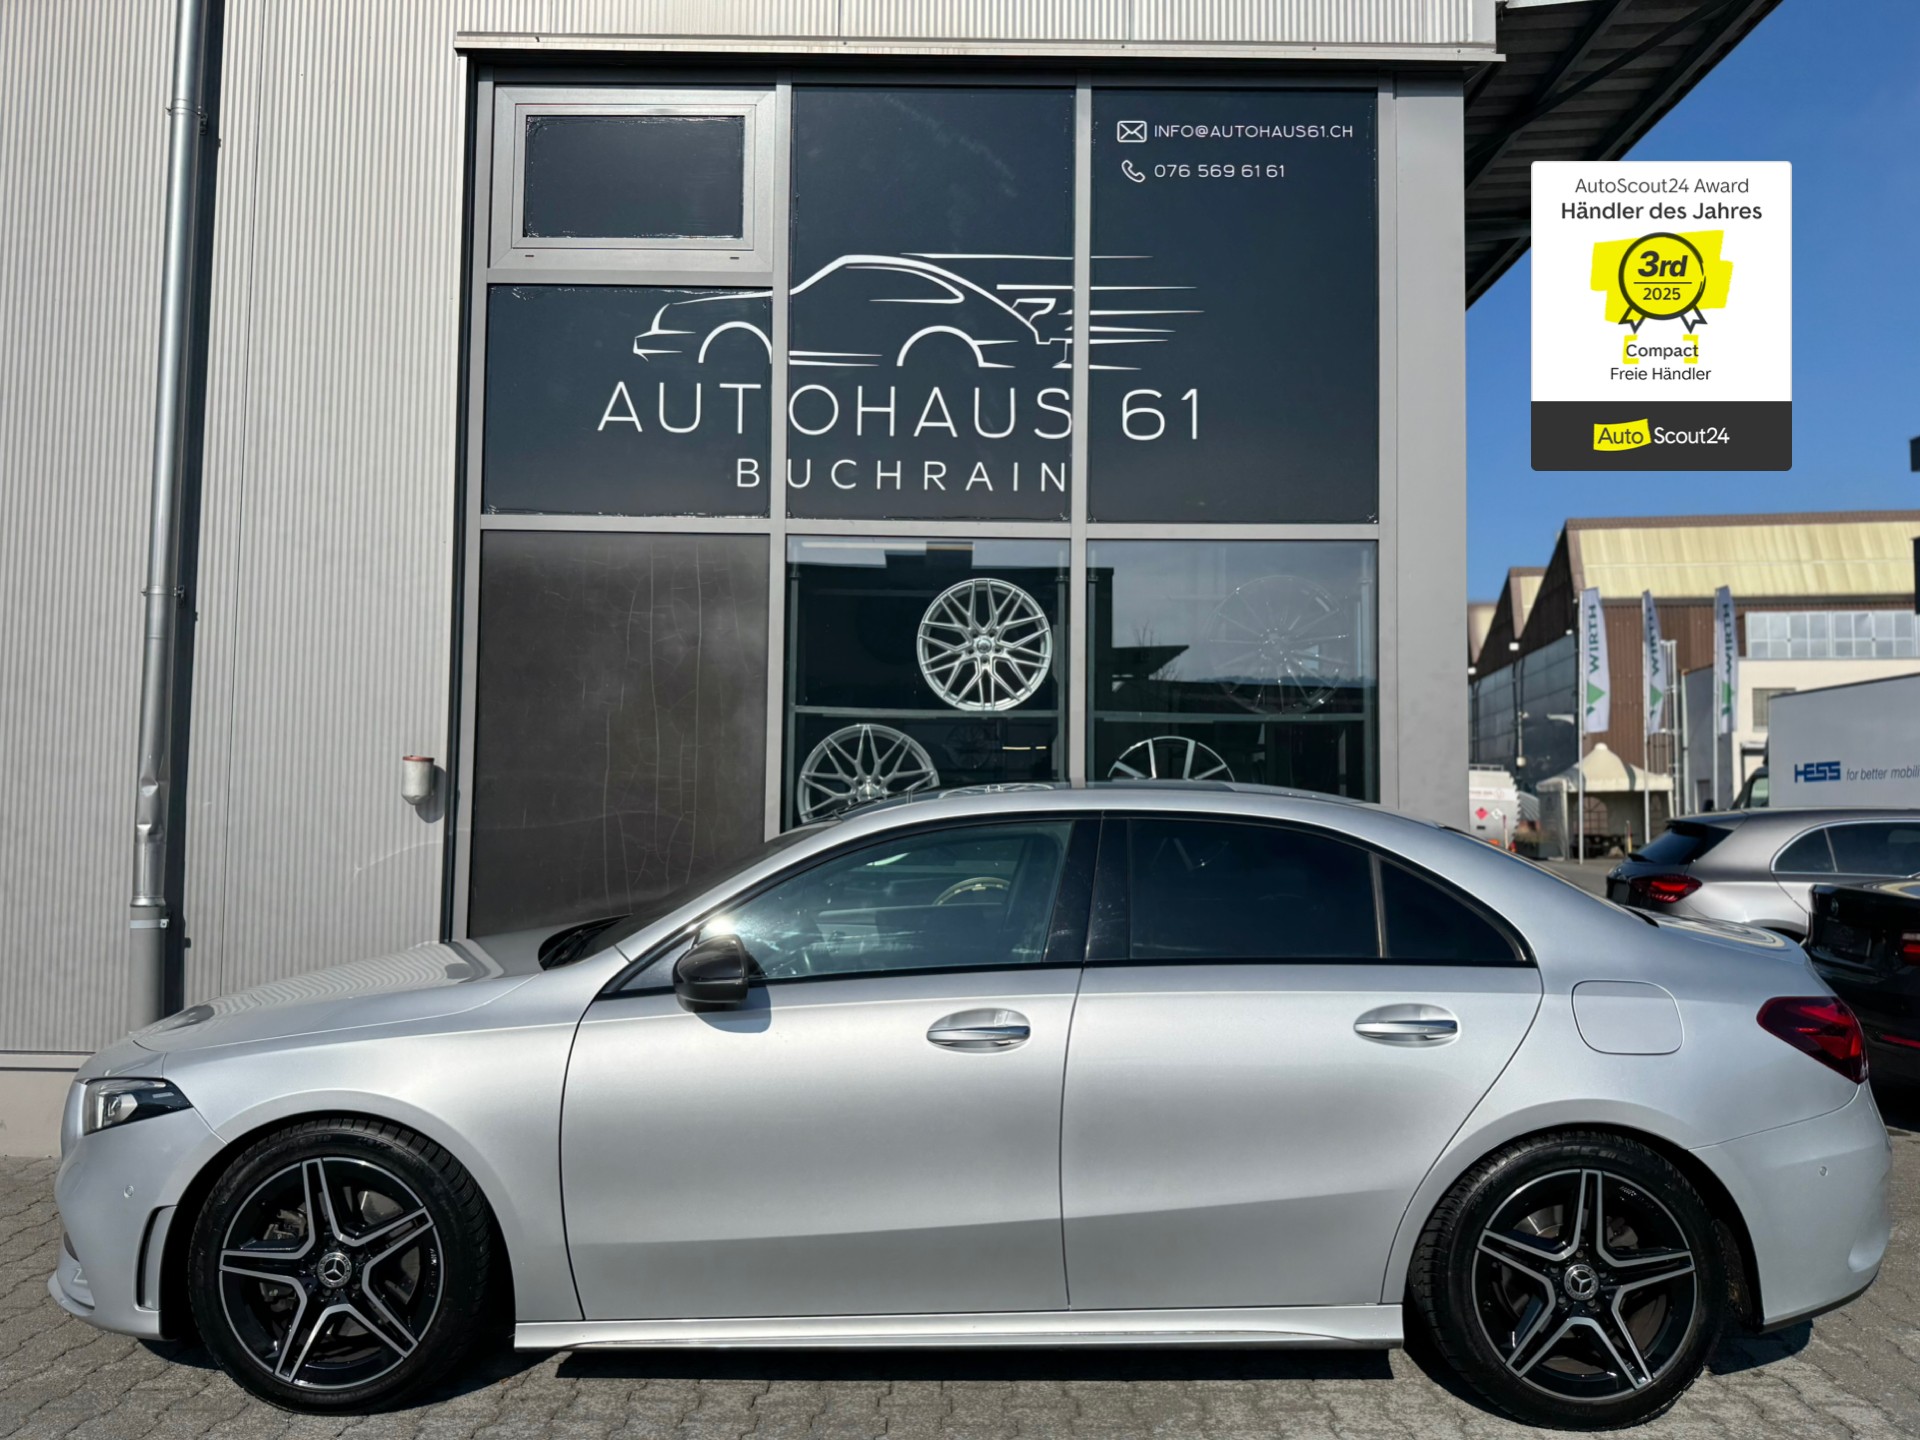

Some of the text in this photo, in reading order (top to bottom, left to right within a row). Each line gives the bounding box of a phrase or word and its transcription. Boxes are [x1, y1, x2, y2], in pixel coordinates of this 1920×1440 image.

[1154, 124, 1353, 138] INFO@AUTOHAUS61.CH
[1154, 164, 1285, 178] 076 569 61 61
[597, 381, 1199, 441] AUTOHAUS 61
[736, 458, 1066, 492] BUCHRAIN
[1588, 604, 1600, 675] WIRTH
[1794, 761, 1841, 783] HESS
[1846, 768, 1859, 781] for
[1860, 767, 1888, 780] better
